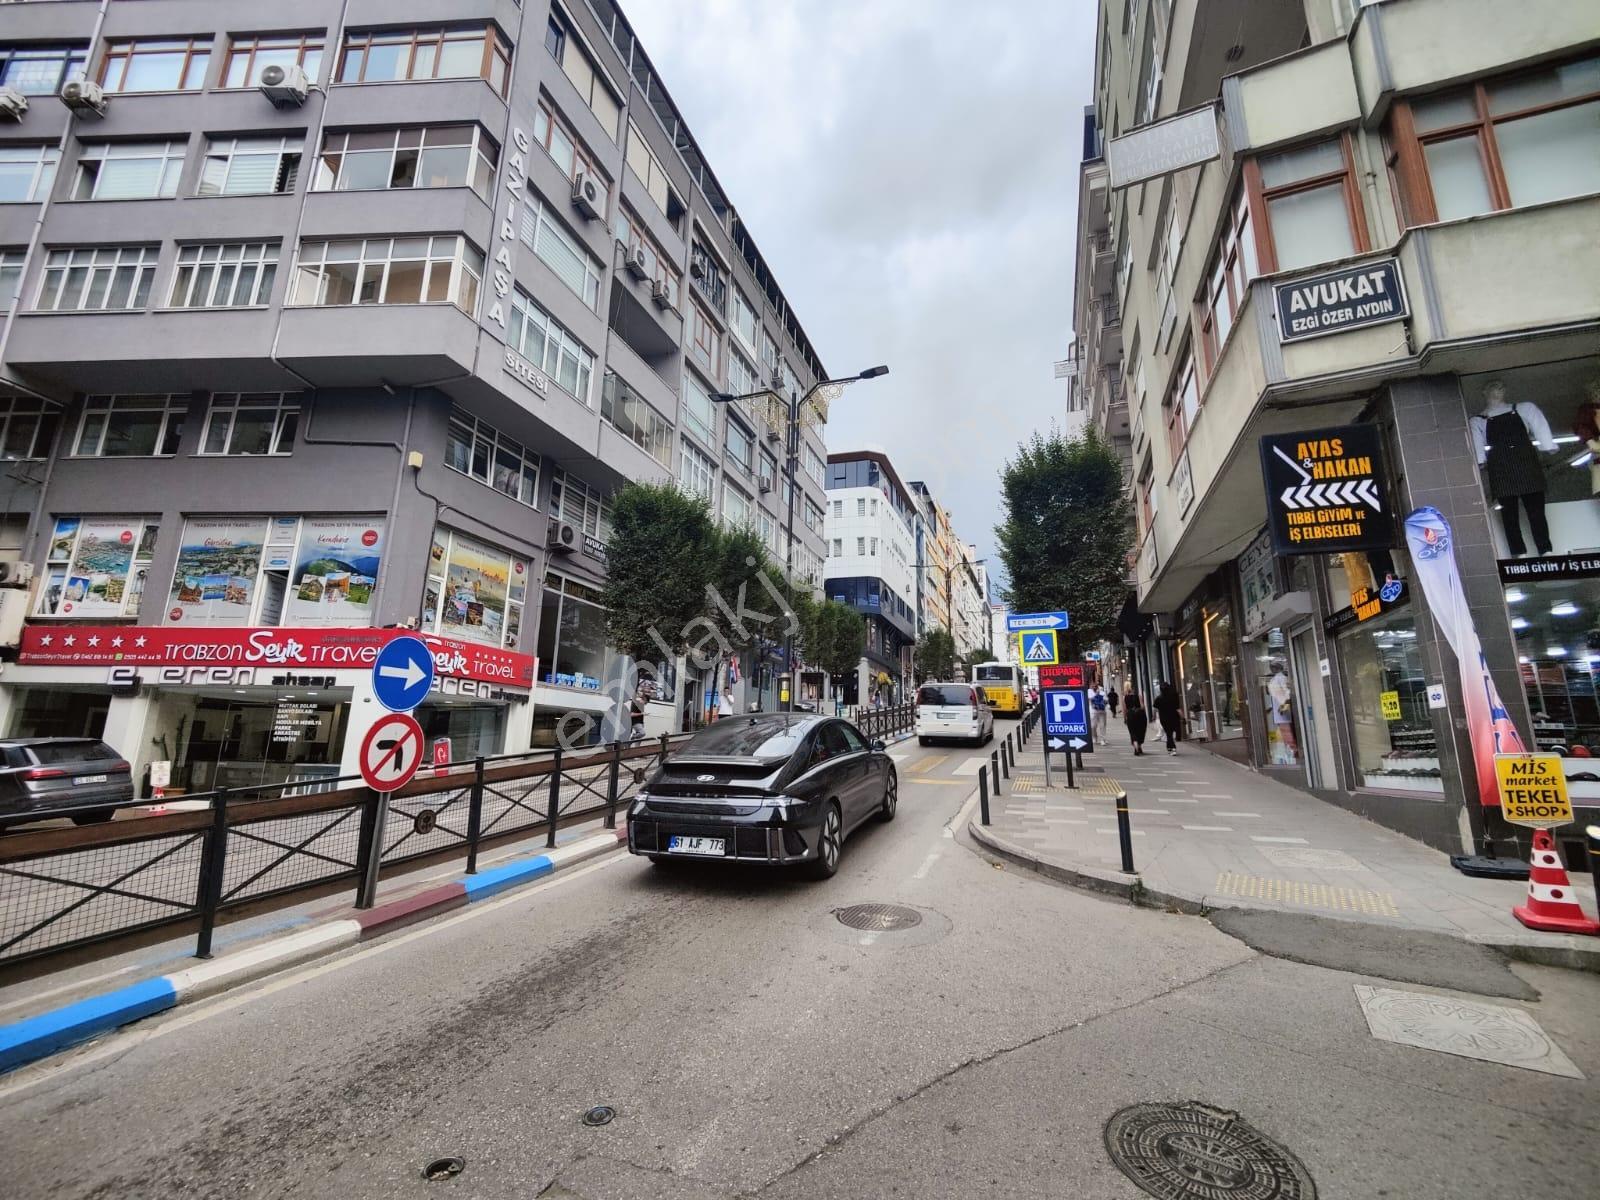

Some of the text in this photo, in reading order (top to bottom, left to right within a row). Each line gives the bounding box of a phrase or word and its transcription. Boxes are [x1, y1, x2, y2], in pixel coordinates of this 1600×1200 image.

[1290, 270, 1386, 313] AVUKAT
[1291, 298, 1394, 333] EZGİ ÖZER AYDIN
[505, 351, 549, 394] SİTESİ
[1297, 438, 1344, 460] AYAS
[1303, 457, 1372, 479] & HAKAN
[1287, 508, 1366, 526] TIBBİ GİYİM VE
[1289, 522, 1362, 544] İŞ ELBİSELERİ
[1504, 562, 1530, 575] TIBBİ
[1531, 561, 1559, 573] GİYİM
[1569, 560, 1579, 571] İŞ
[160, 666, 256, 685] eren
[1041, 667, 1081, 676] OTOPARK
[1052, 693, 1076, 722] P
[1048, 725, 1085, 734] OTOPARK
[1511, 759, 1547, 775] MİS
[1505, 776, 1558, 786] market
[1505, 790, 1565, 804] TEKEL
[1515, 806, 1559, 817] SHOP
[675, 837, 724, 850] 61 AJF 773
